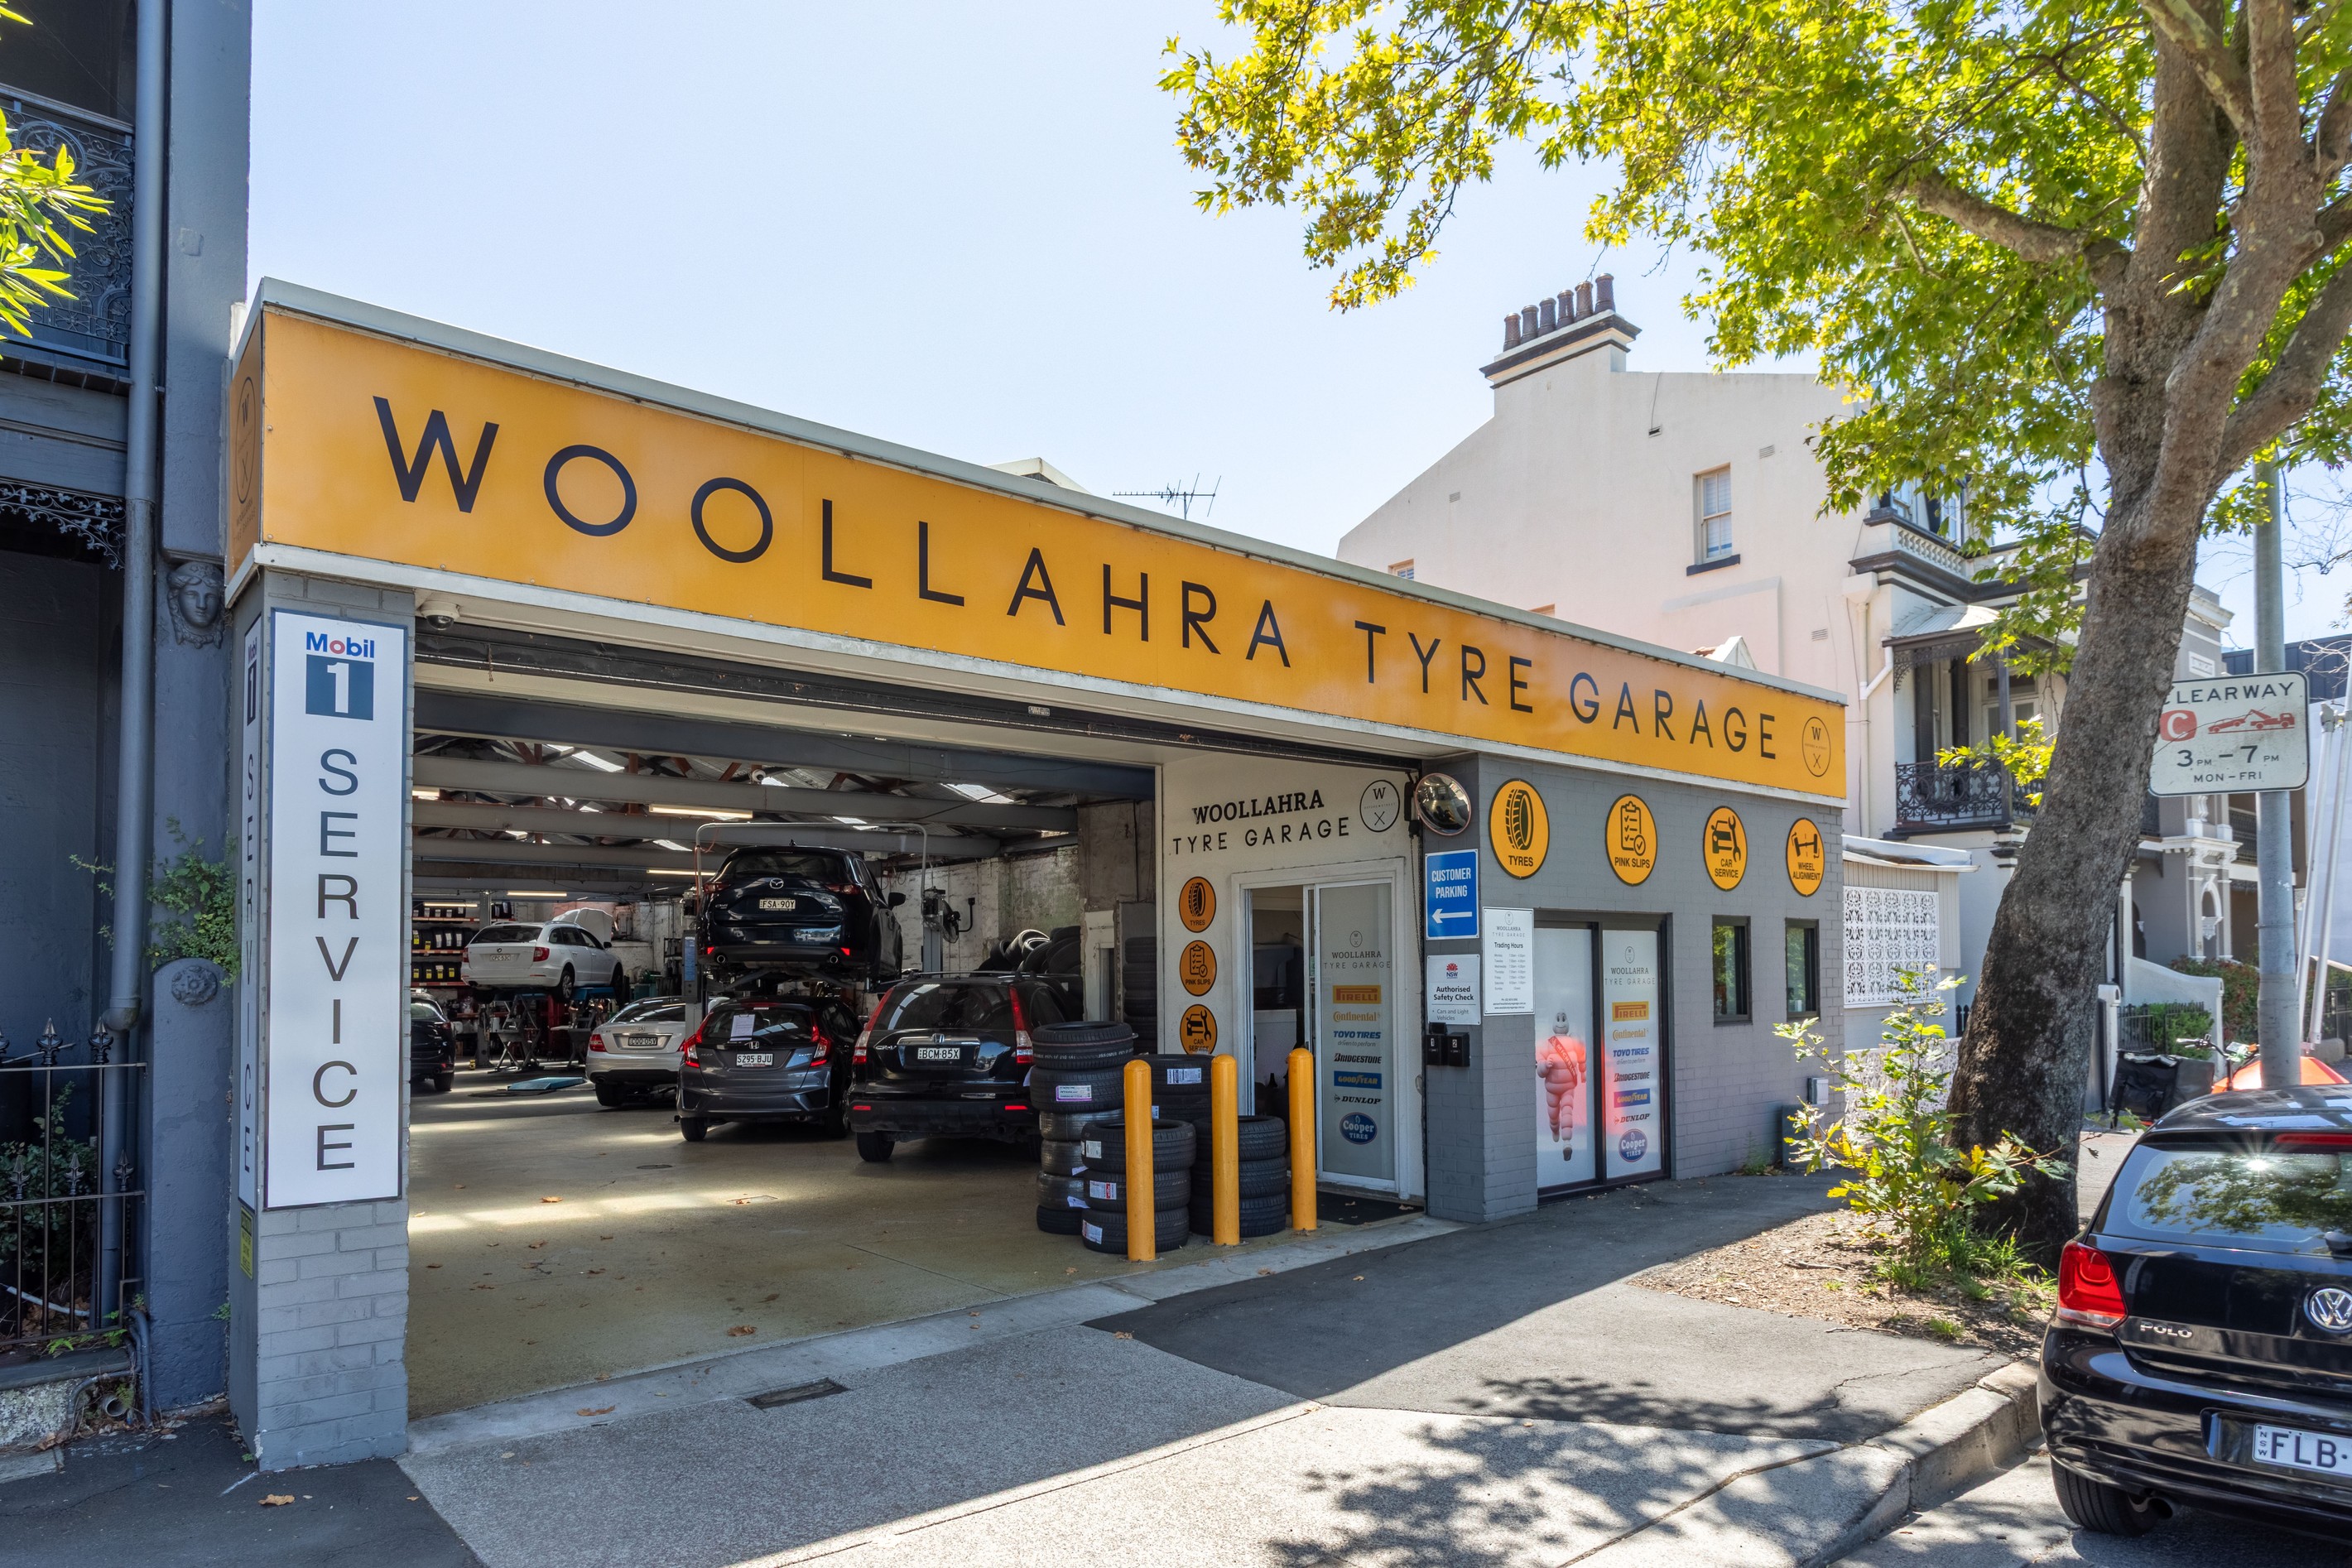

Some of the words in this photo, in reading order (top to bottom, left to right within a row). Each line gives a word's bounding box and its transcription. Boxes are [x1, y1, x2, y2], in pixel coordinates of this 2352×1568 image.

[373, 396, 1291, 668] WOOLLAHRA
[1354, 620, 1533, 714] TYRE
[1570, 672, 1776, 759] GARAGE
[306, 631, 374, 659] Mobil
[327, 661, 349, 714] 1
[2163, 682, 2294, 705] LEARWAY
[2167, 713, 2188, 739] C
[1811, 726, 1821, 741] W
[1373, 787, 1386, 800] W
[1192, 789, 1325, 825] WOOLLAHRA
[1172, 832, 1228, 855] TYRE
[1245, 816, 1349, 846] GARAGE
[1508, 855, 1534, 868] TYRES
[1614, 857, 1630, 868] PINK
[1631, 858, 1650, 869] SLIPS
[1720, 858, 1733, 868] CAR
[1798, 862, 1815, 872] WHEEL
[1431, 868, 1471, 883] CUSTOMER
[1715, 868, 1739, 878] SERVICE
[1792, 872, 1821, 881] ALIGNMENT
[1436, 885, 1468, 899] PARKING
[1494, 941, 1510, 950] Trading
[312, 748, 359, 1171] SERVICE
[1352, 960, 1391, 969] GARAGE
[1627, 977, 1656, 985] GARAGE
[1335, 988, 1378, 1001] PIRELLI
[1434, 993, 1454, 1002] Safety
[1614, 1004, 1647, 1018] PIRELLI
[1613, 1048, 1631, 1057] TOYO
[1631, 1046, 1649, 1056] TIRES
[1334, 1052, 1382, 1065] BRIDGESTONE
[1614, 1071, 1650, 1082] BRIDGESTONE
[1341, 1096, 1381, 1104] DUNLOP
[1620, 1113, 1650, 1123] DUNLOP
[1343, 1120, 1374, 1133] Cooper
[1621, 1138, 1646, 1150] Cooper
[1626, 1149, 1641, 1157] TIRES
[2140, 1320, 2193, 1339] POLO
